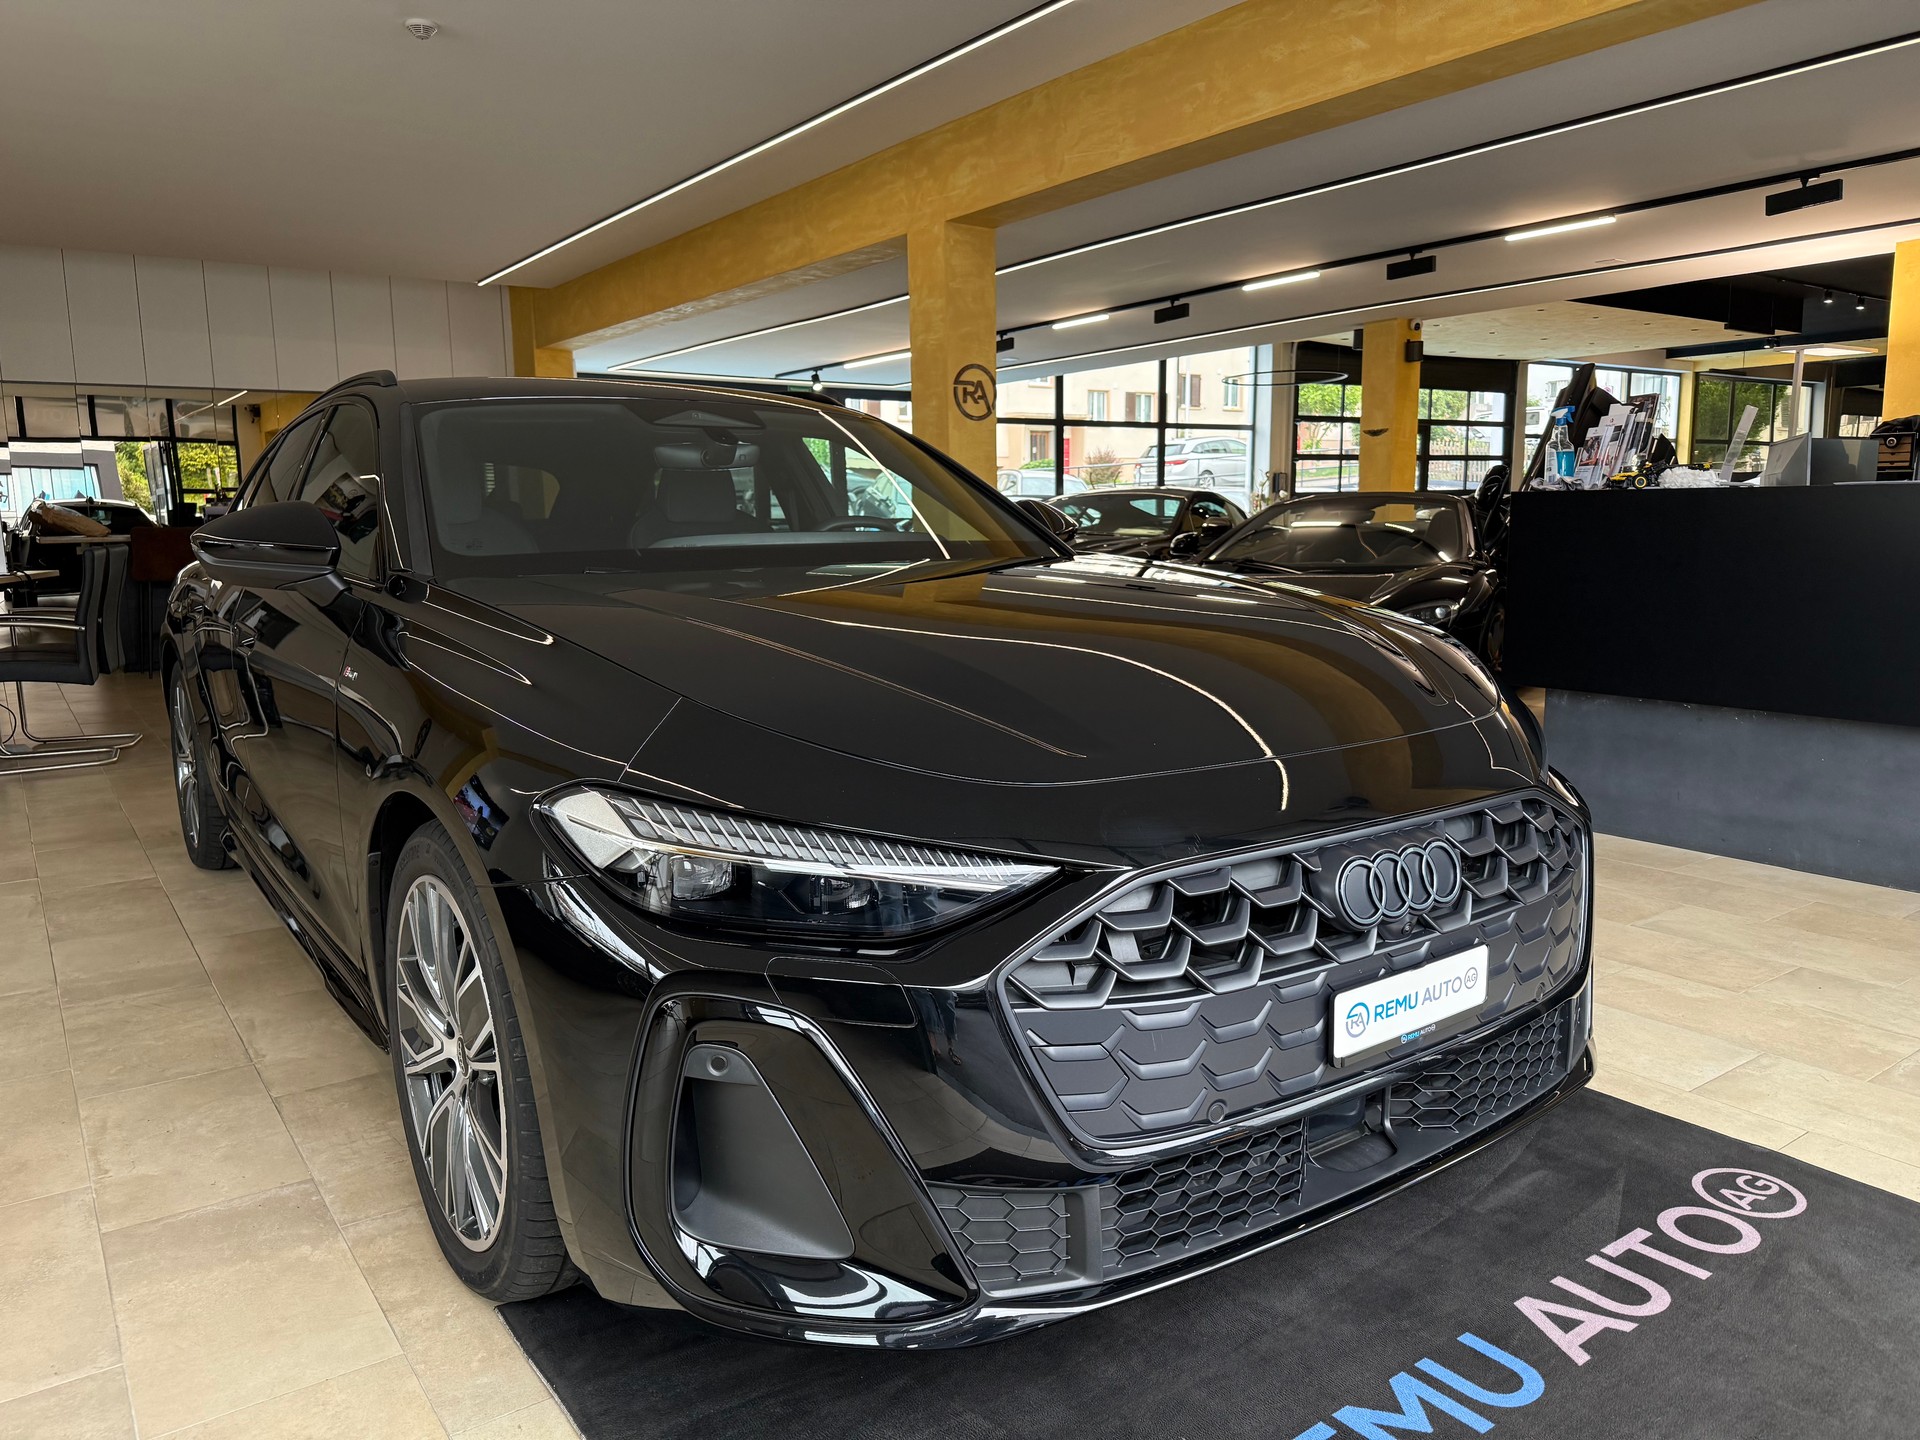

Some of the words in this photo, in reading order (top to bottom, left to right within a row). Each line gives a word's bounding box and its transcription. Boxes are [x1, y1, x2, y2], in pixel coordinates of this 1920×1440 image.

[1374, 991, 1419, 1022] REMU
[1421, 976, 1462, 1006] AUTO
[1293, 1332, 1546, 1440] MU
[1514, 1206, 1762, 1367] AUTO
